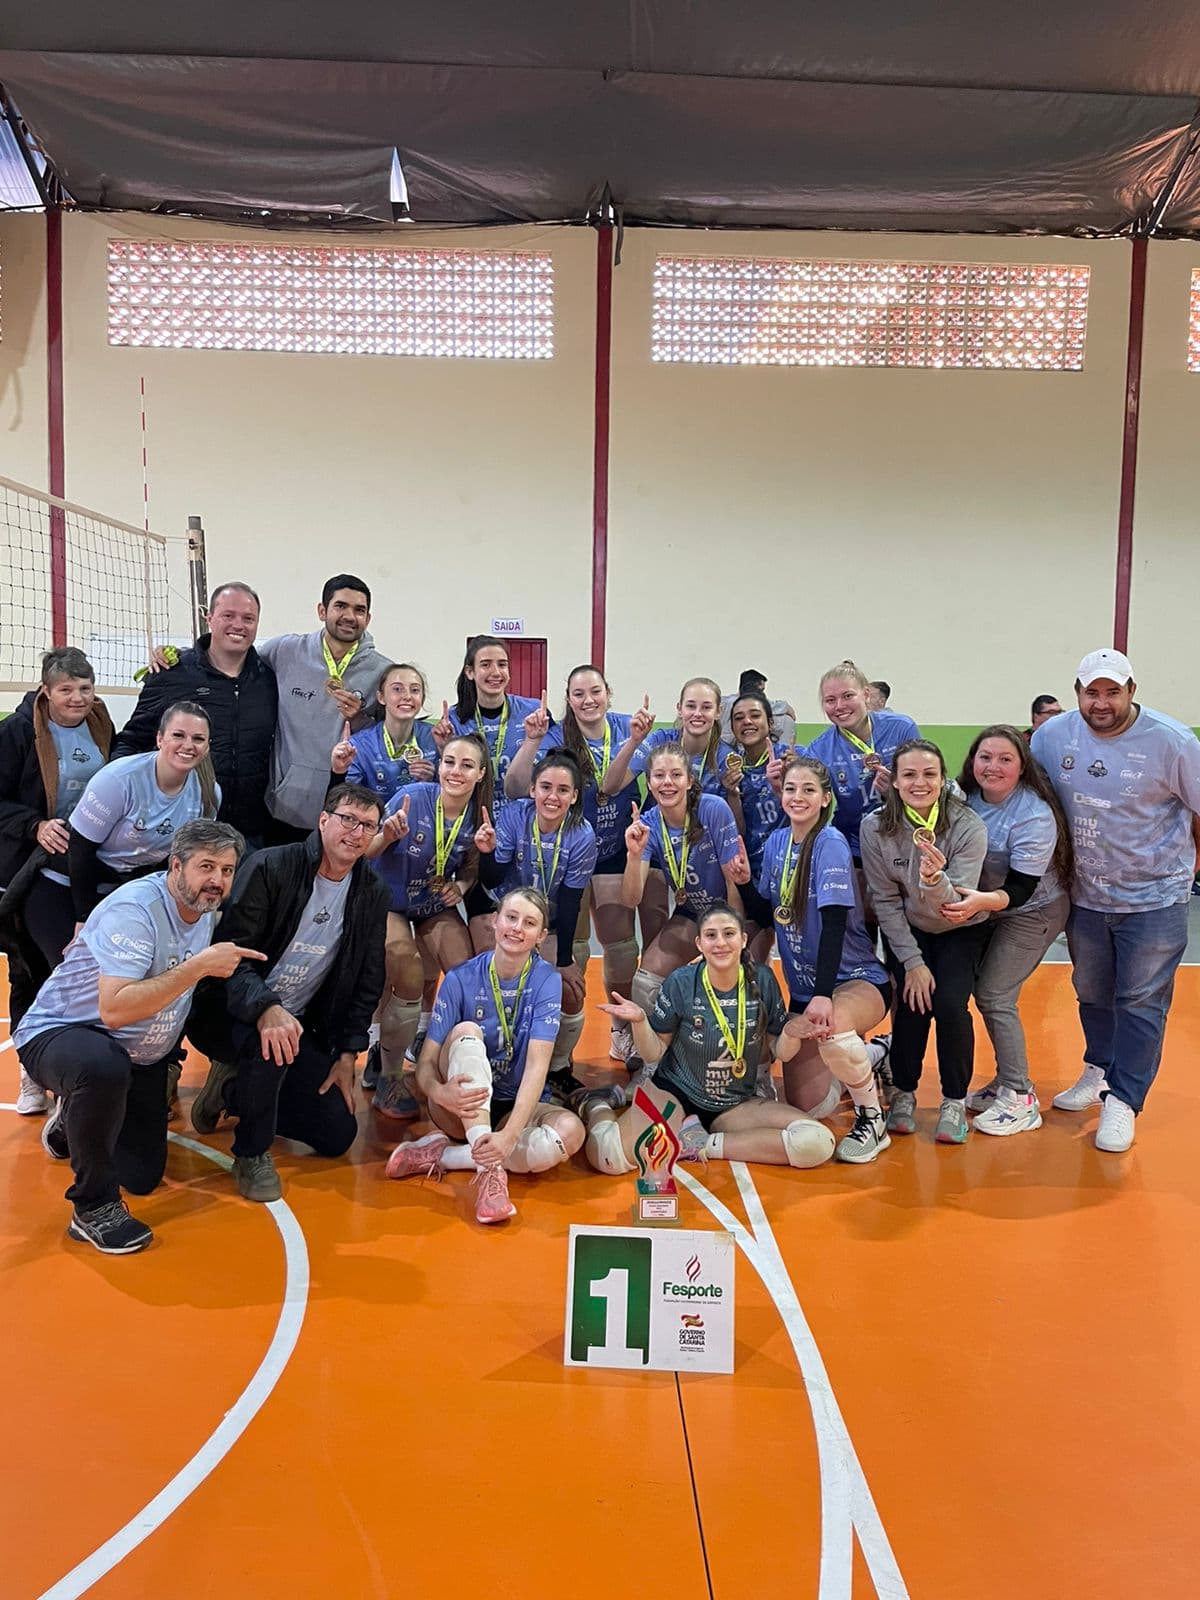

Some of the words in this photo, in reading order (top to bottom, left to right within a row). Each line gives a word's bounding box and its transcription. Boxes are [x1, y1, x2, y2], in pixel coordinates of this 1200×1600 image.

[494, 621, 521, 631] SAIDA
[1073, 792, 1112, 809] Dass
[755, 800, 779, 825] 18
[1073, 815, 1099, 830] my
[1073, 826, 1101, 839] pur
[1073, 837, 1097, 849] ple
[686, 864, 701, 885] 6
[291, 941, 328, 955] Dass
[706, 1069, 730, 1080] my
[663, 1282, 723, 1299] Fesporte
[587, 1268, 644, 1364] 1
